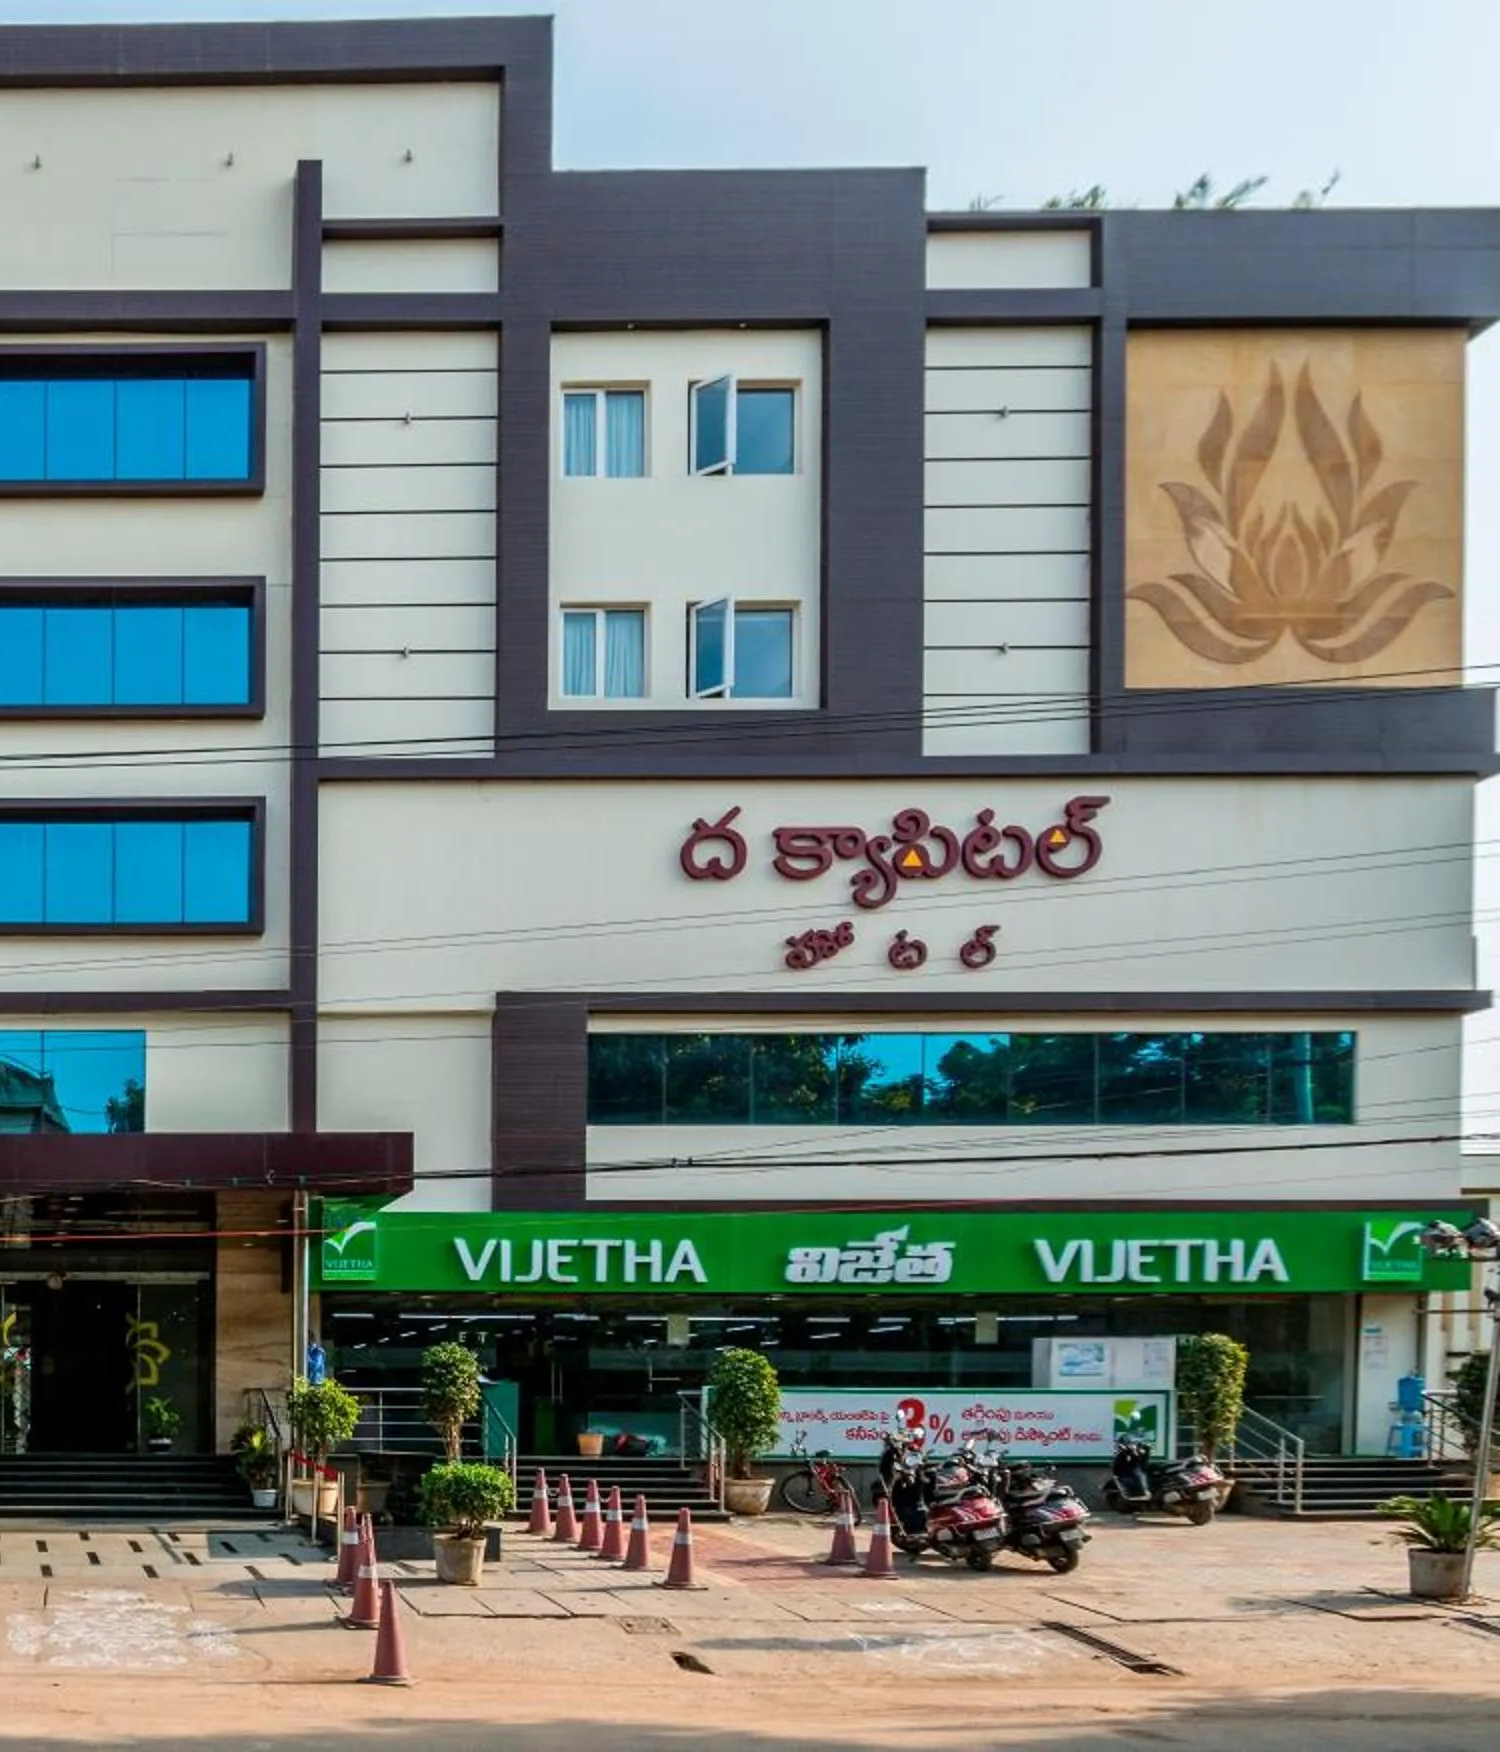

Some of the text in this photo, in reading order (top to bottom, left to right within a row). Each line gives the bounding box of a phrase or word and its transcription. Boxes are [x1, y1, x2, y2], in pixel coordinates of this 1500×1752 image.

[679, 795, 1111, 909] ద క్యాపిటల్
[453, 1237, 708, 1283] VIJETHA
[784, 1223, 957, 1284] విజేత
[1033, 1238, 1290, 1283] VIJETHA
